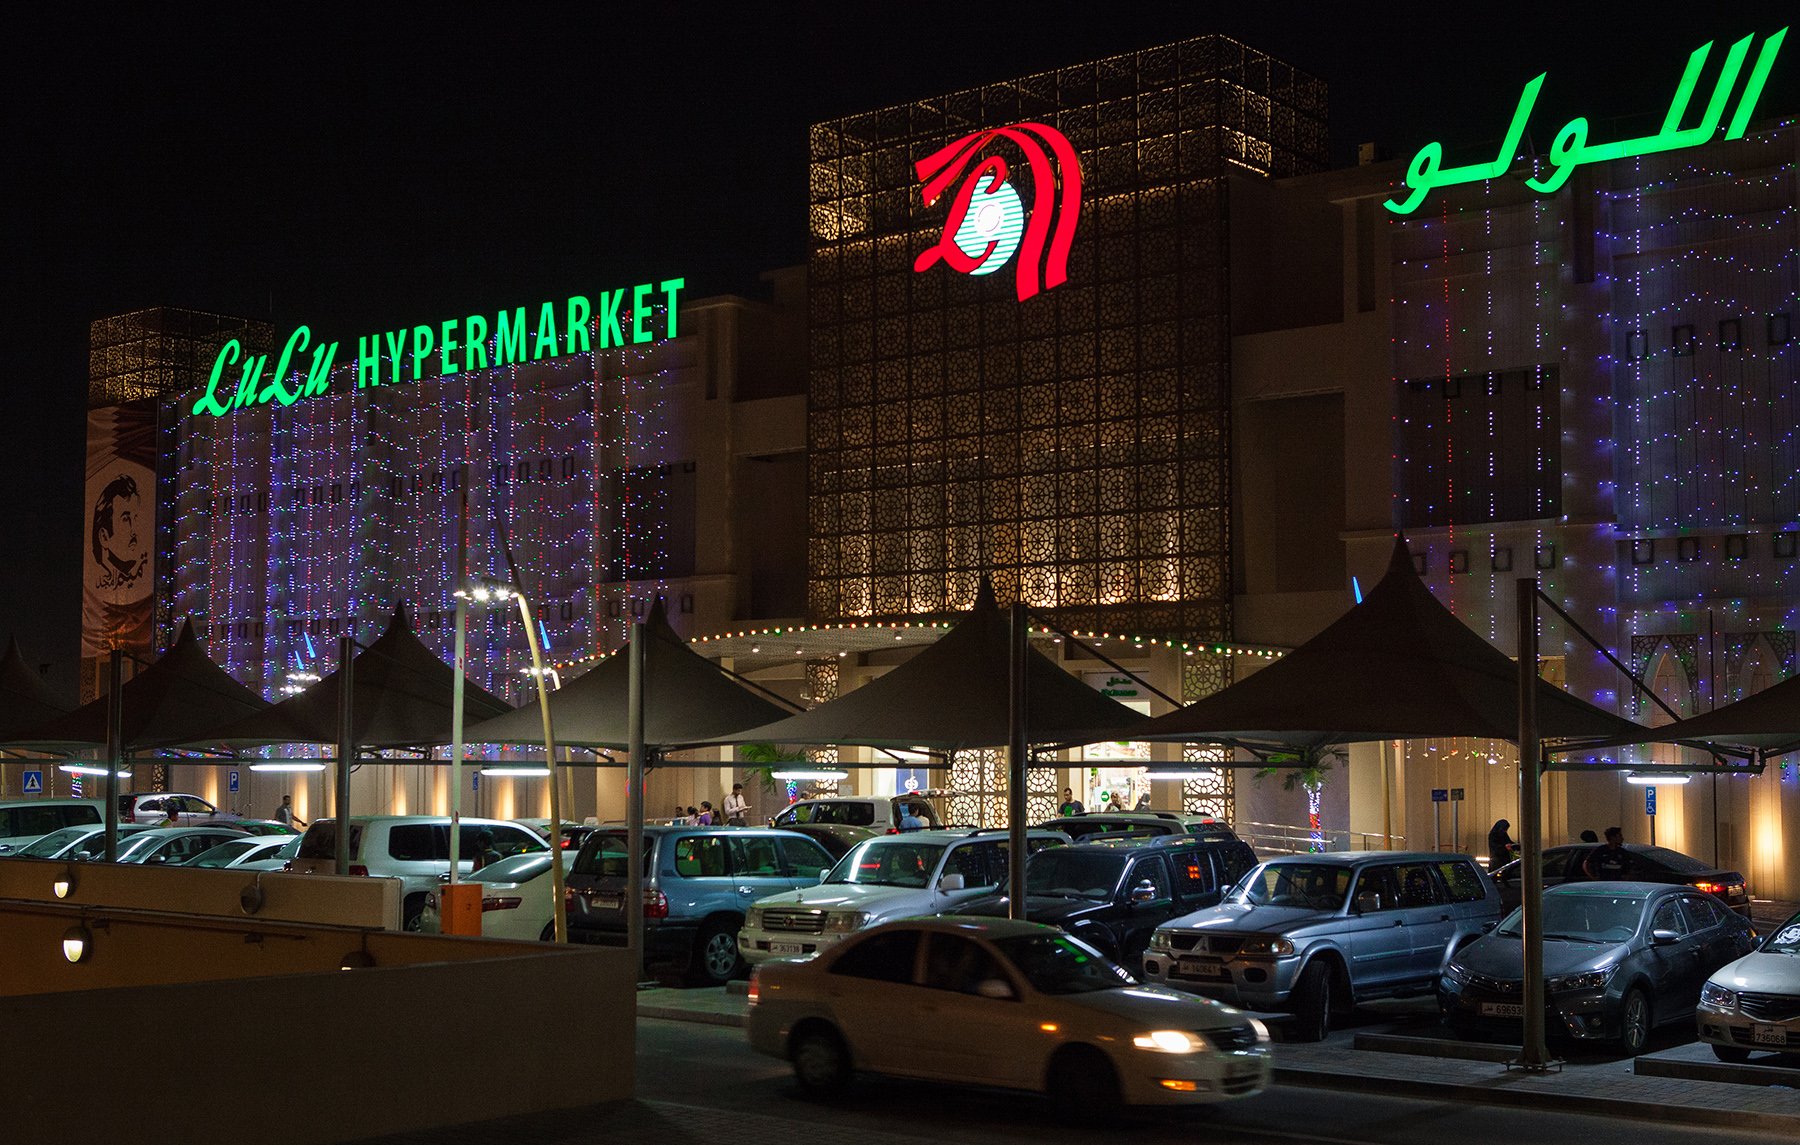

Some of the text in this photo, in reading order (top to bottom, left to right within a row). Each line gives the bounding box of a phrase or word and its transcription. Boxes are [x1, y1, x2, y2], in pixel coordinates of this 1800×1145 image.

[1383, 25, 1789, 214] اللولو
[192, 277, 685, 417] LuLu HYPERMARKET
[231, 773, 238, 785] P
[1647, 789, 1654, 799] P
